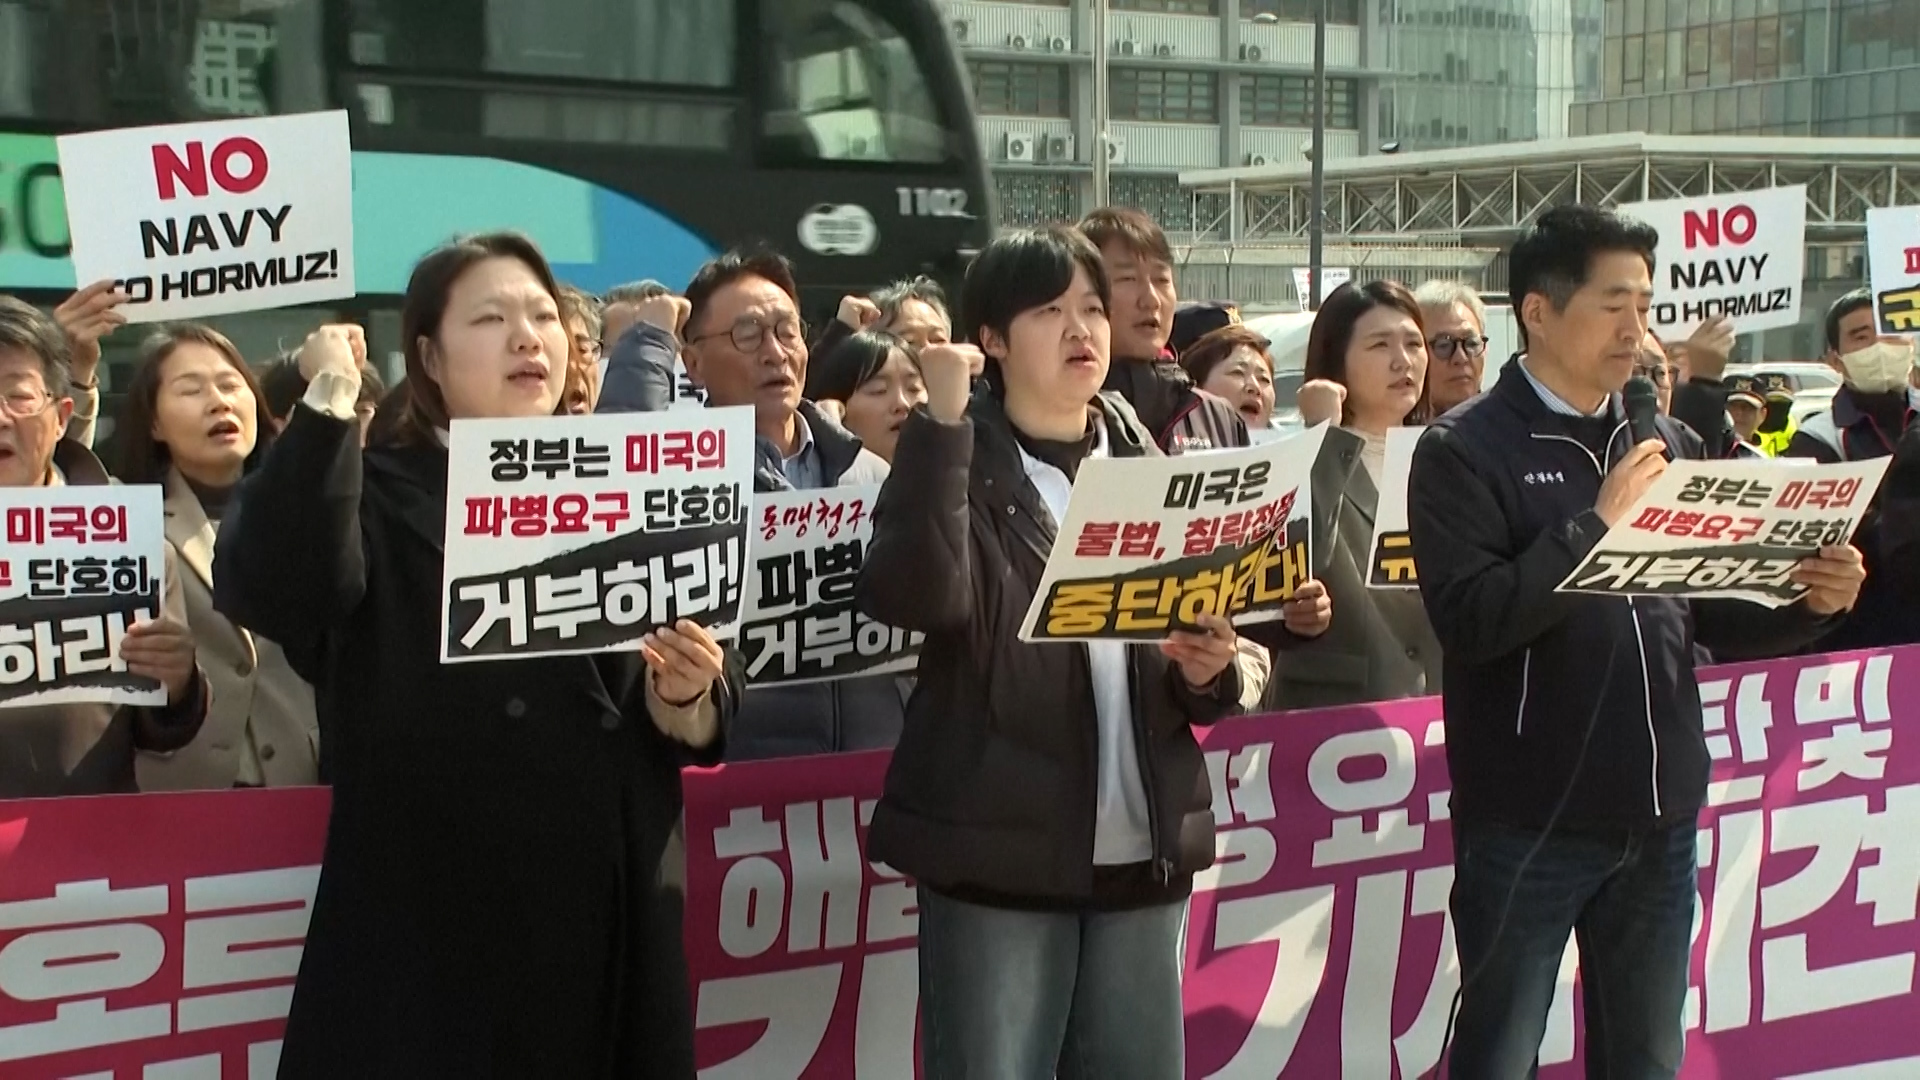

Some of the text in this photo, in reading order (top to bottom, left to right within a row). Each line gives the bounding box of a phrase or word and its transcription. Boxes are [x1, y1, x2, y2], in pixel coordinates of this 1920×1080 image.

[151, 136, 269, 201] NO
[139, 204, 292, 259] NAVY
[1683, 204, 1758, 249] NO
[161, 249, 338, 301] HORMUZ!
[1670, 253, 1769, 290] NAVY
[1683, 287, 1791, 323] HORMUZ!
[489, 429, 726, 482] 정부는 미국의
[1163, 460, 1272, 510] 미국은
[1677, 475, 1863, 510] 정부는 미국의
[6, 505, 128, 544] 미국의
[463, 482, 741, 537] 파병요구 단호히
[1630, 507, 1853, 547] 파병요구 단호히
[1074, 521, 1166, 560] 불법,
[28, 555, 148, 596] 단호히
[459, 536, 740, 650] 거부하라!
[1794, 655, 1894, 792] 및
